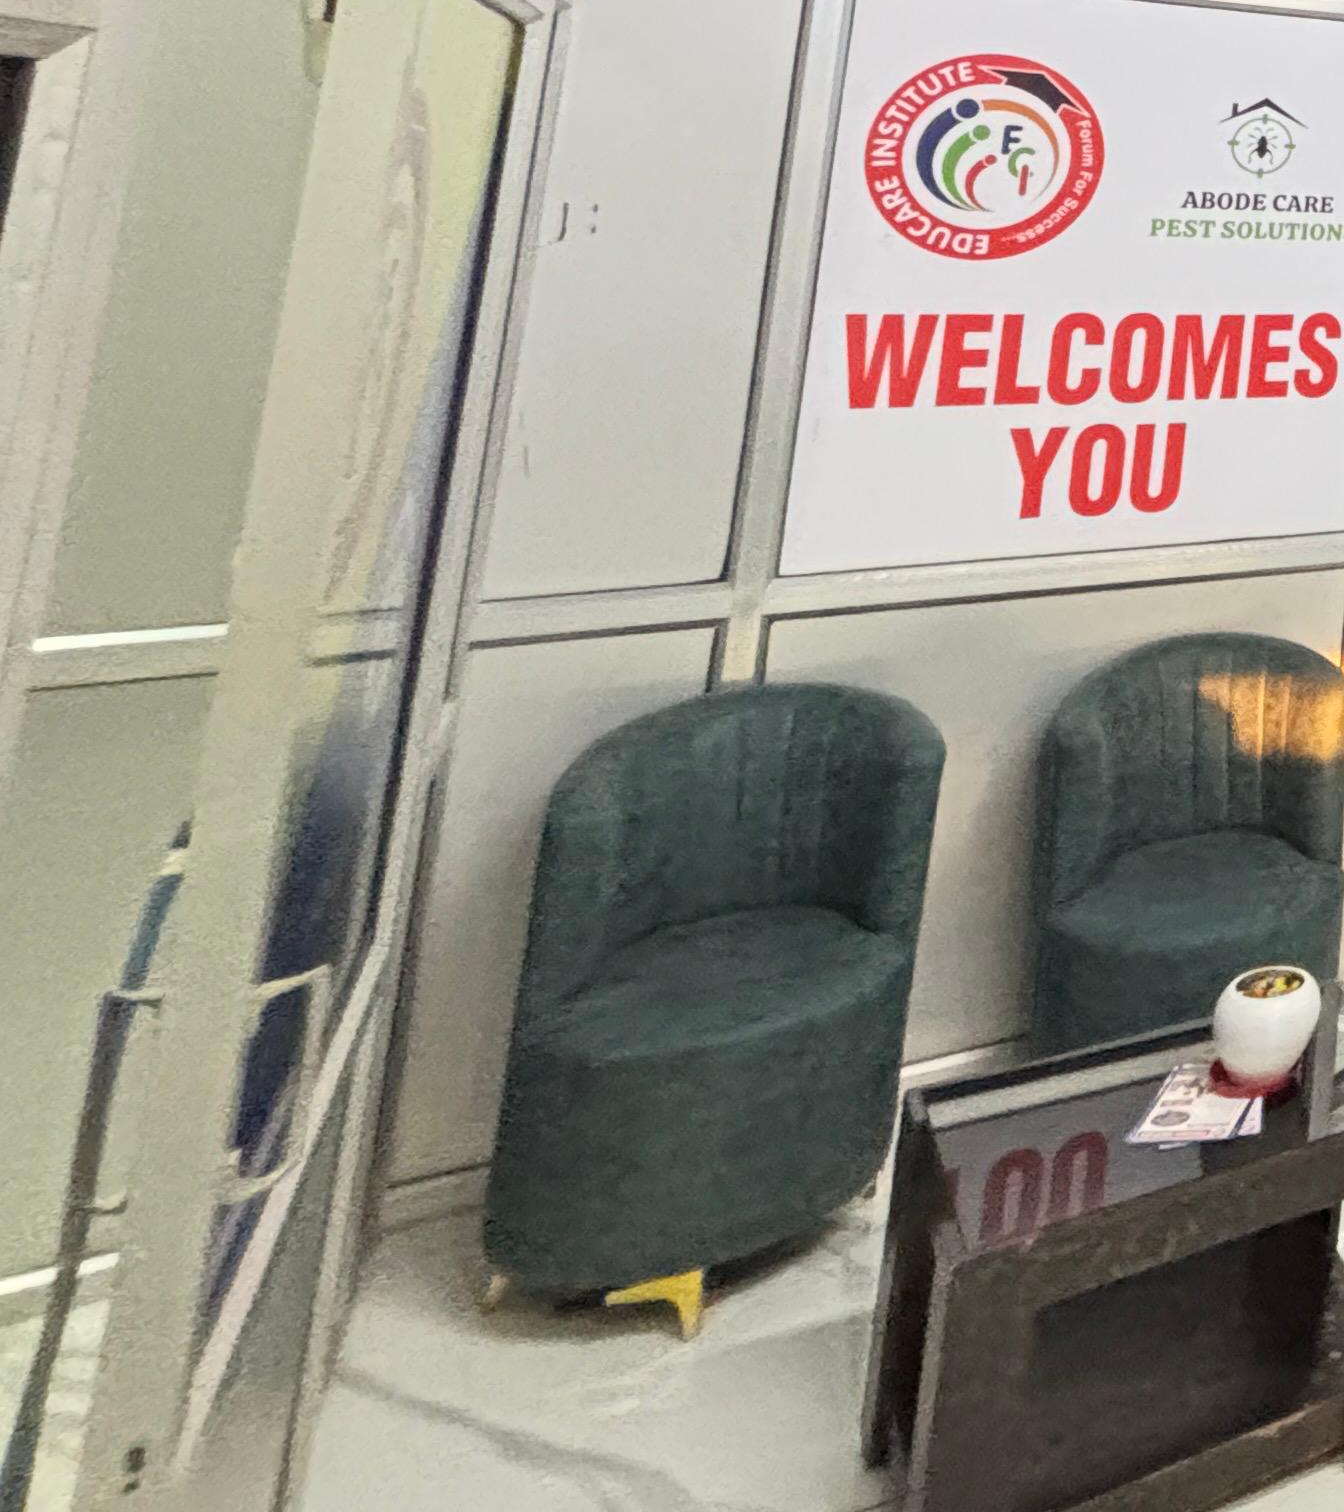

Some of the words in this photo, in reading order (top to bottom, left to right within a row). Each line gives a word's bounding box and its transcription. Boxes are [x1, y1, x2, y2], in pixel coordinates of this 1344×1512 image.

[871, 61, 976, 168] INSTITUTE
[1076, 119, 1094, 168] Forum
[874, 175, 990, 255] EDUCARE
[1074, 171, 1094, 198] For
[1181, 191, 1267, 212] ABODE
[1272, 194, 1335, 214] CARE
[1149, 218, 1216, 239] PEST
[845, 311, 1342, 409] WELCOMES
[1010, 422, 1187, 519] YOU
